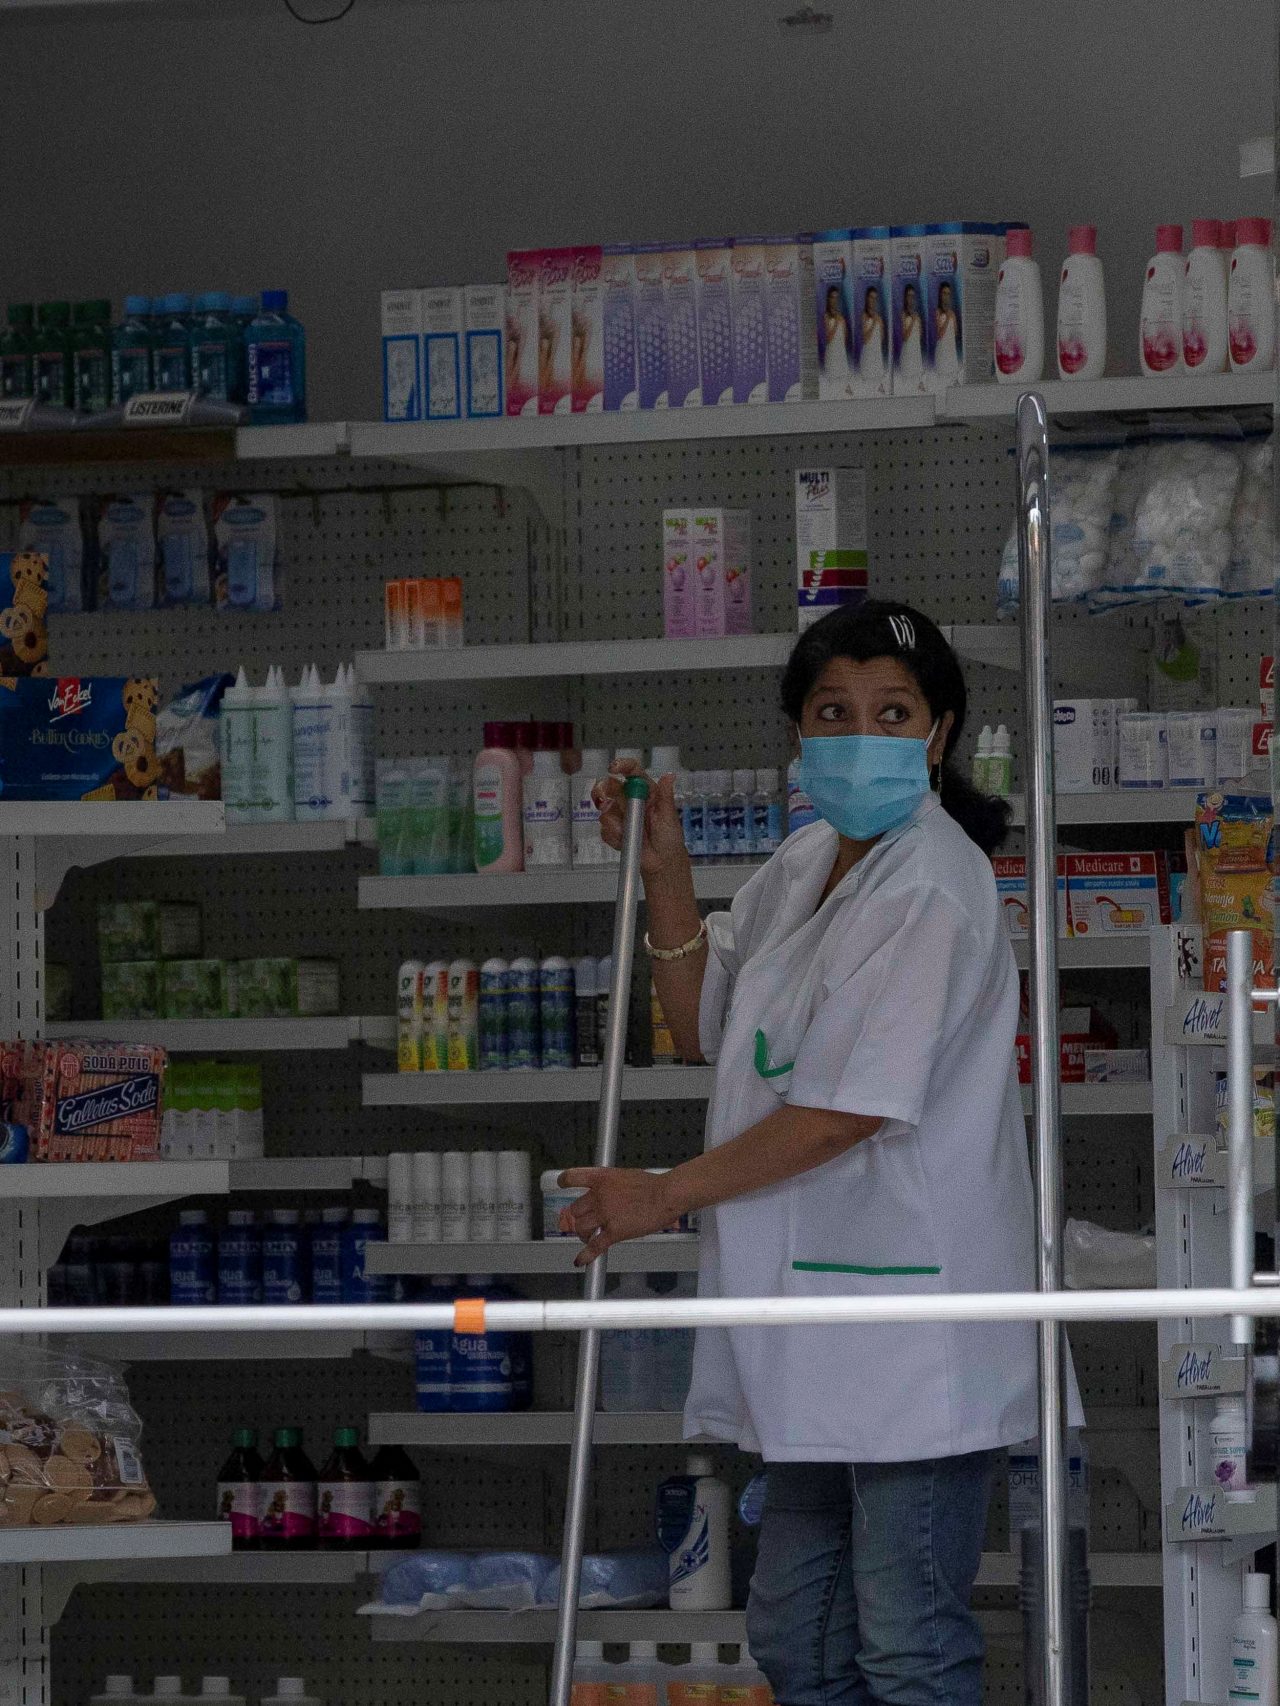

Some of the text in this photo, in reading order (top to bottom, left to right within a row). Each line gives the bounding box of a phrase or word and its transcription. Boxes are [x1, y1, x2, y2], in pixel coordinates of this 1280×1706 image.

[130, 400, 184, 416] LISTERINE
[800, 472, 829, 484] MULTI
[1074, 858, 1124, 873] Medicare
[83, 1056, 149, 1070] SODA PUIG
[451, 1336, 488, 1356] Agua
